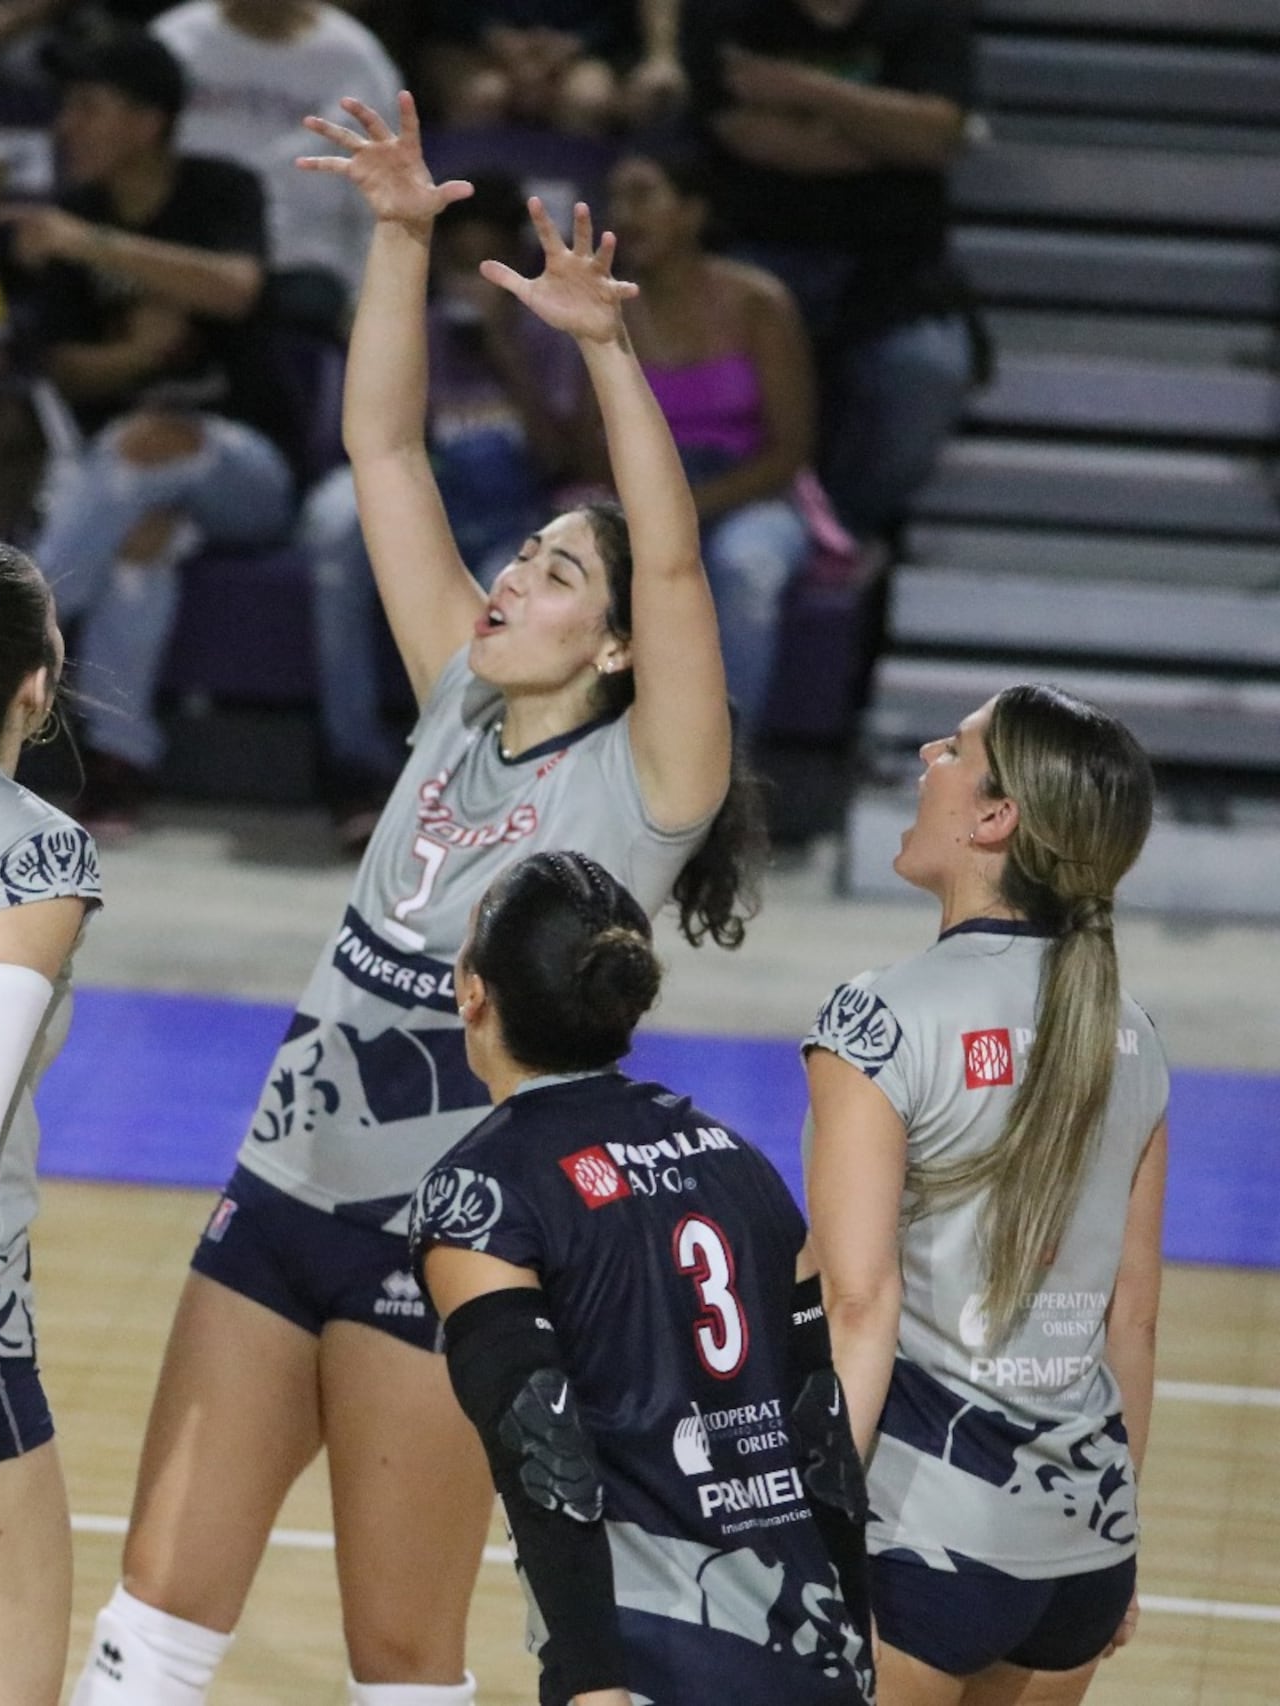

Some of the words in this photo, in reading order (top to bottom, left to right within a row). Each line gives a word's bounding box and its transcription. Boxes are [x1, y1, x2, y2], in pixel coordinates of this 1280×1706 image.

[393, 833, 450, 922] 7
[671, 1211, 750, 1381] 3
[703, 1399, 782, 1432] COOPERAT
